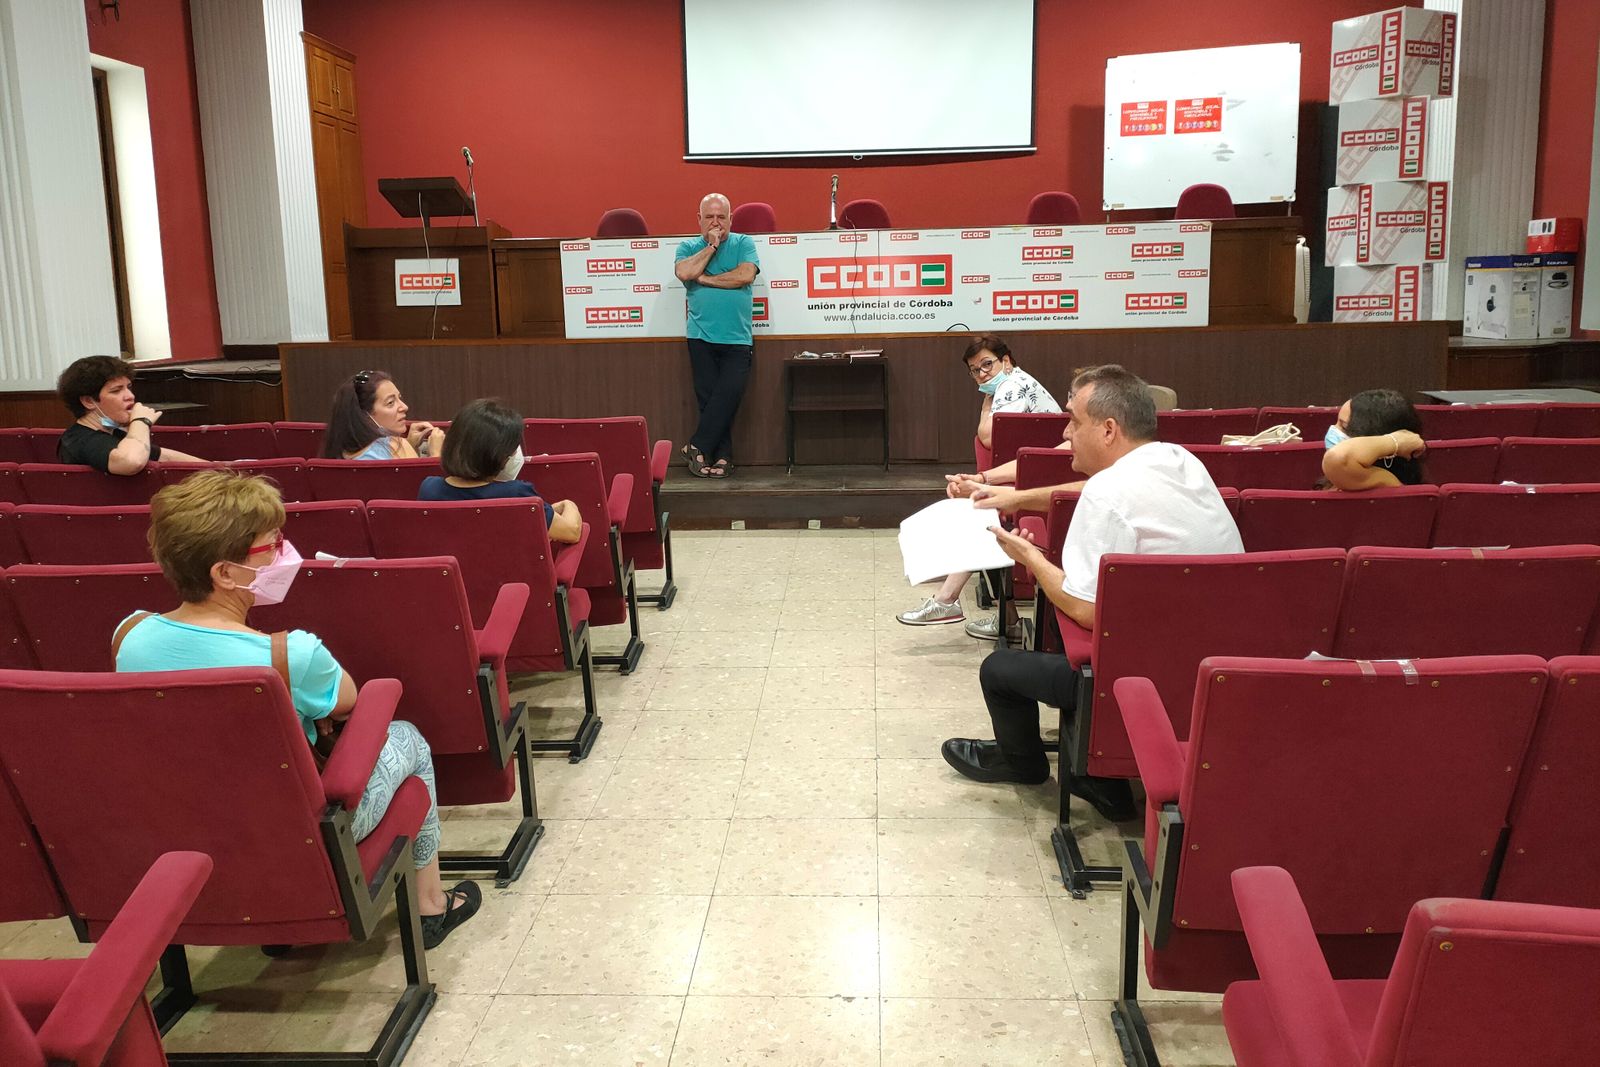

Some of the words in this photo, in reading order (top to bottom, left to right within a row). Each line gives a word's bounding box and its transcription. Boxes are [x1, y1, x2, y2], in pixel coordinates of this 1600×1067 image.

[1354, 61, 1379, 71] Córdoba
[807, 302, 836, 310] unión
[839, 300, 890, 311] provincial
[893, 300, 906, 308] de
[909, 299, 953, 308] Córdoba
[823, 312, 936, 322] www.andalucia.ccoo.es
